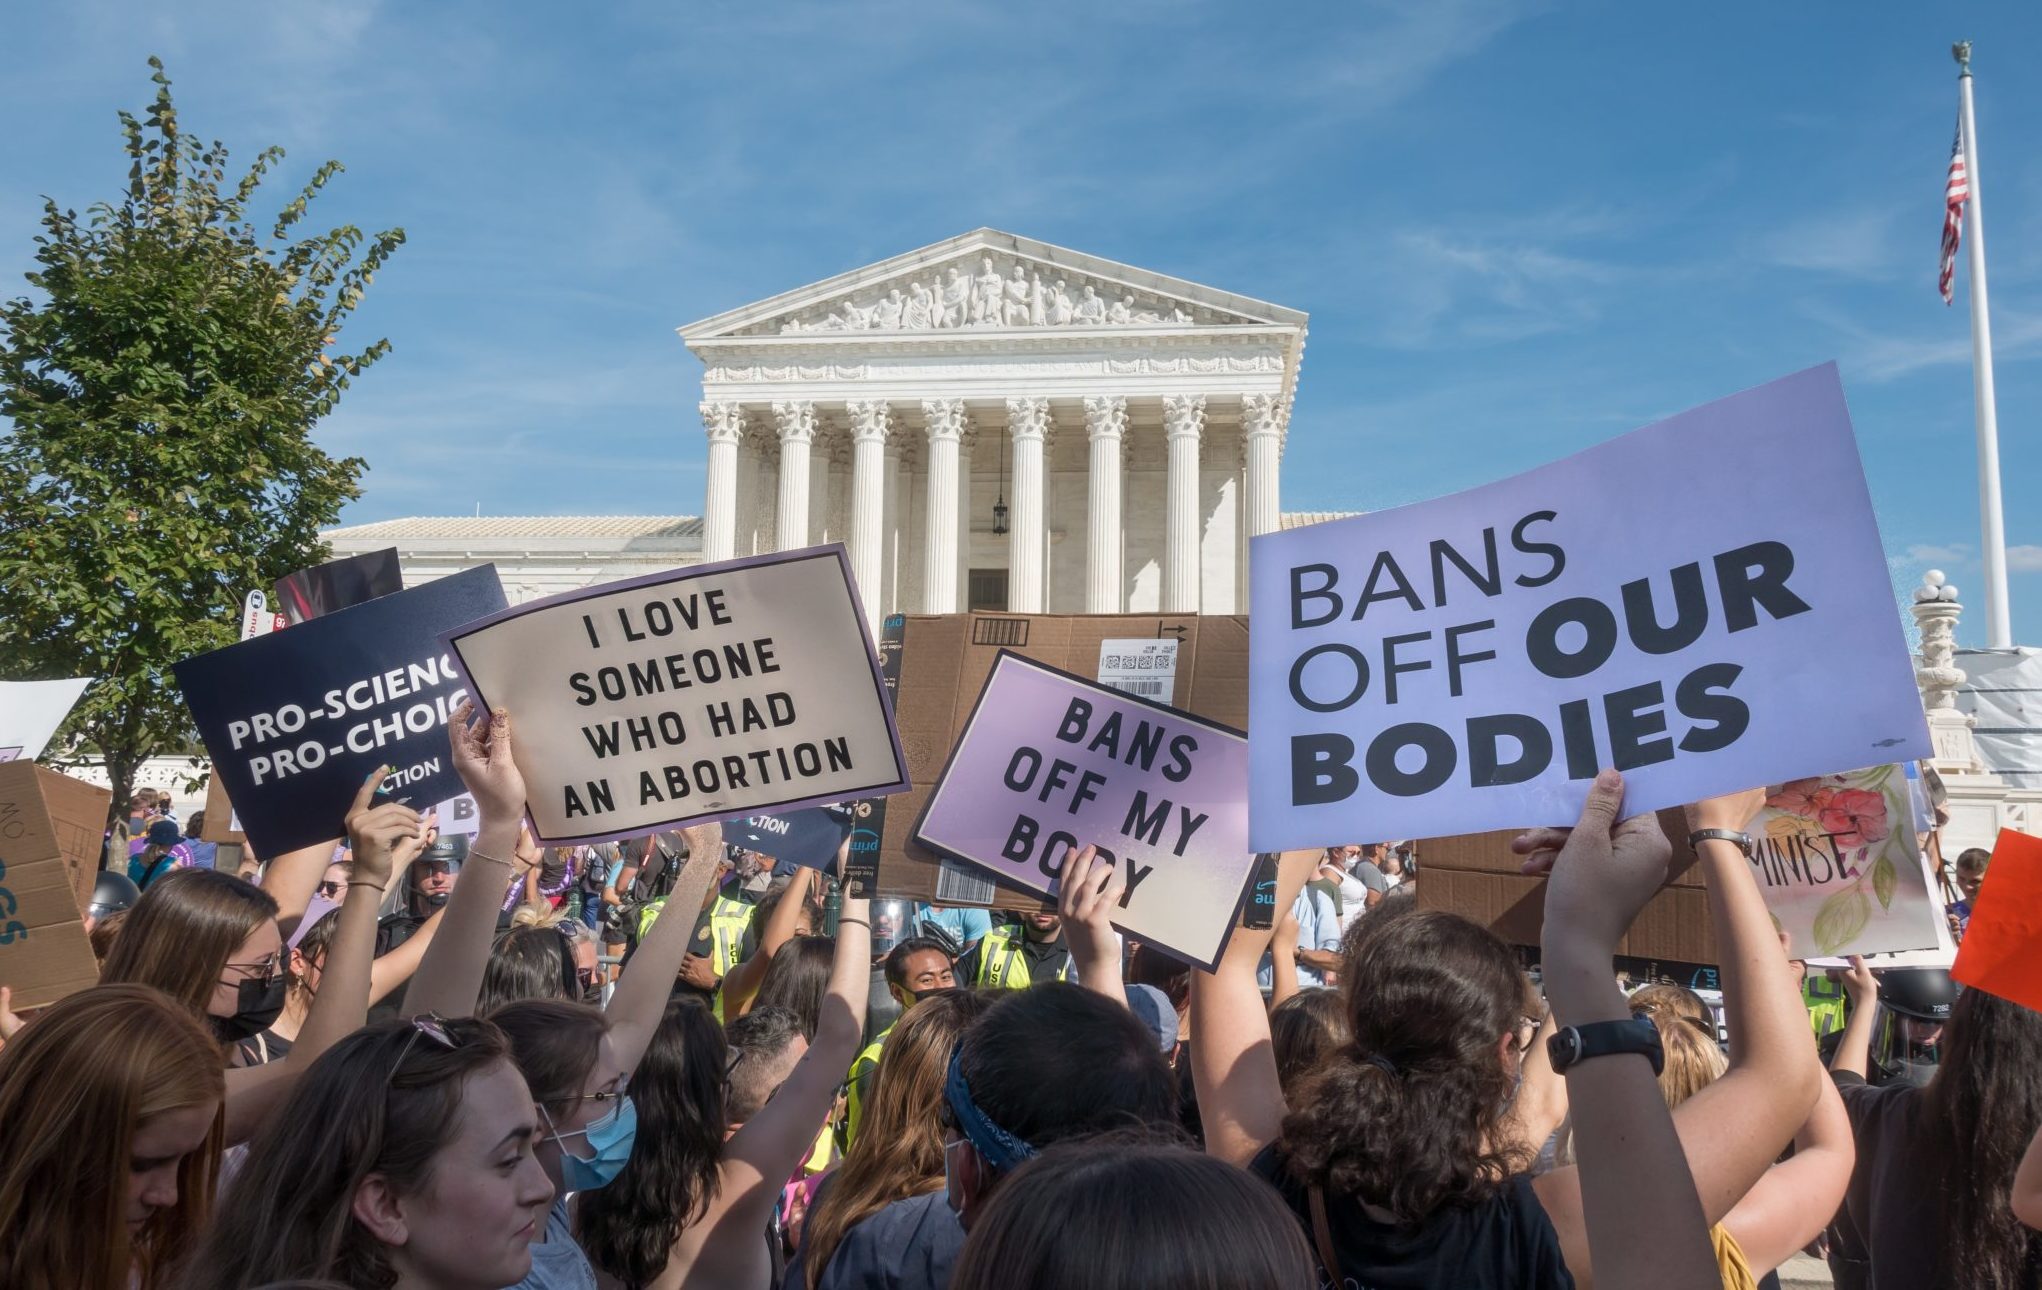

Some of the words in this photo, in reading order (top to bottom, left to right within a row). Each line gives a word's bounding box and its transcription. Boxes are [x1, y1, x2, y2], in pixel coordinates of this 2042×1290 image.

[1291, 510, 1566, 629] BANS
[582, 615, 600, 648] I
[617, 589, 732, 642] LOVE
[1288, 619, 1497, 713] OFF
[1526, 540, 1813, 679] OUR
[569, 638, 780, 706] SOMEONE
[582, 711, 687, 759] WHO
[706, 691, 797, 737] HAD
[1056, 696, 1198, 782] BANS
[1291, 662, 1750, 806] BODIES
[376, 757, 441, 794] CTION
[564, 778, 616, 818] AN
[640, 737, 853, 806] ABORTION
[1003, 746, 1107, 815] OFF
[1120, 790, 1210, 857] MY
